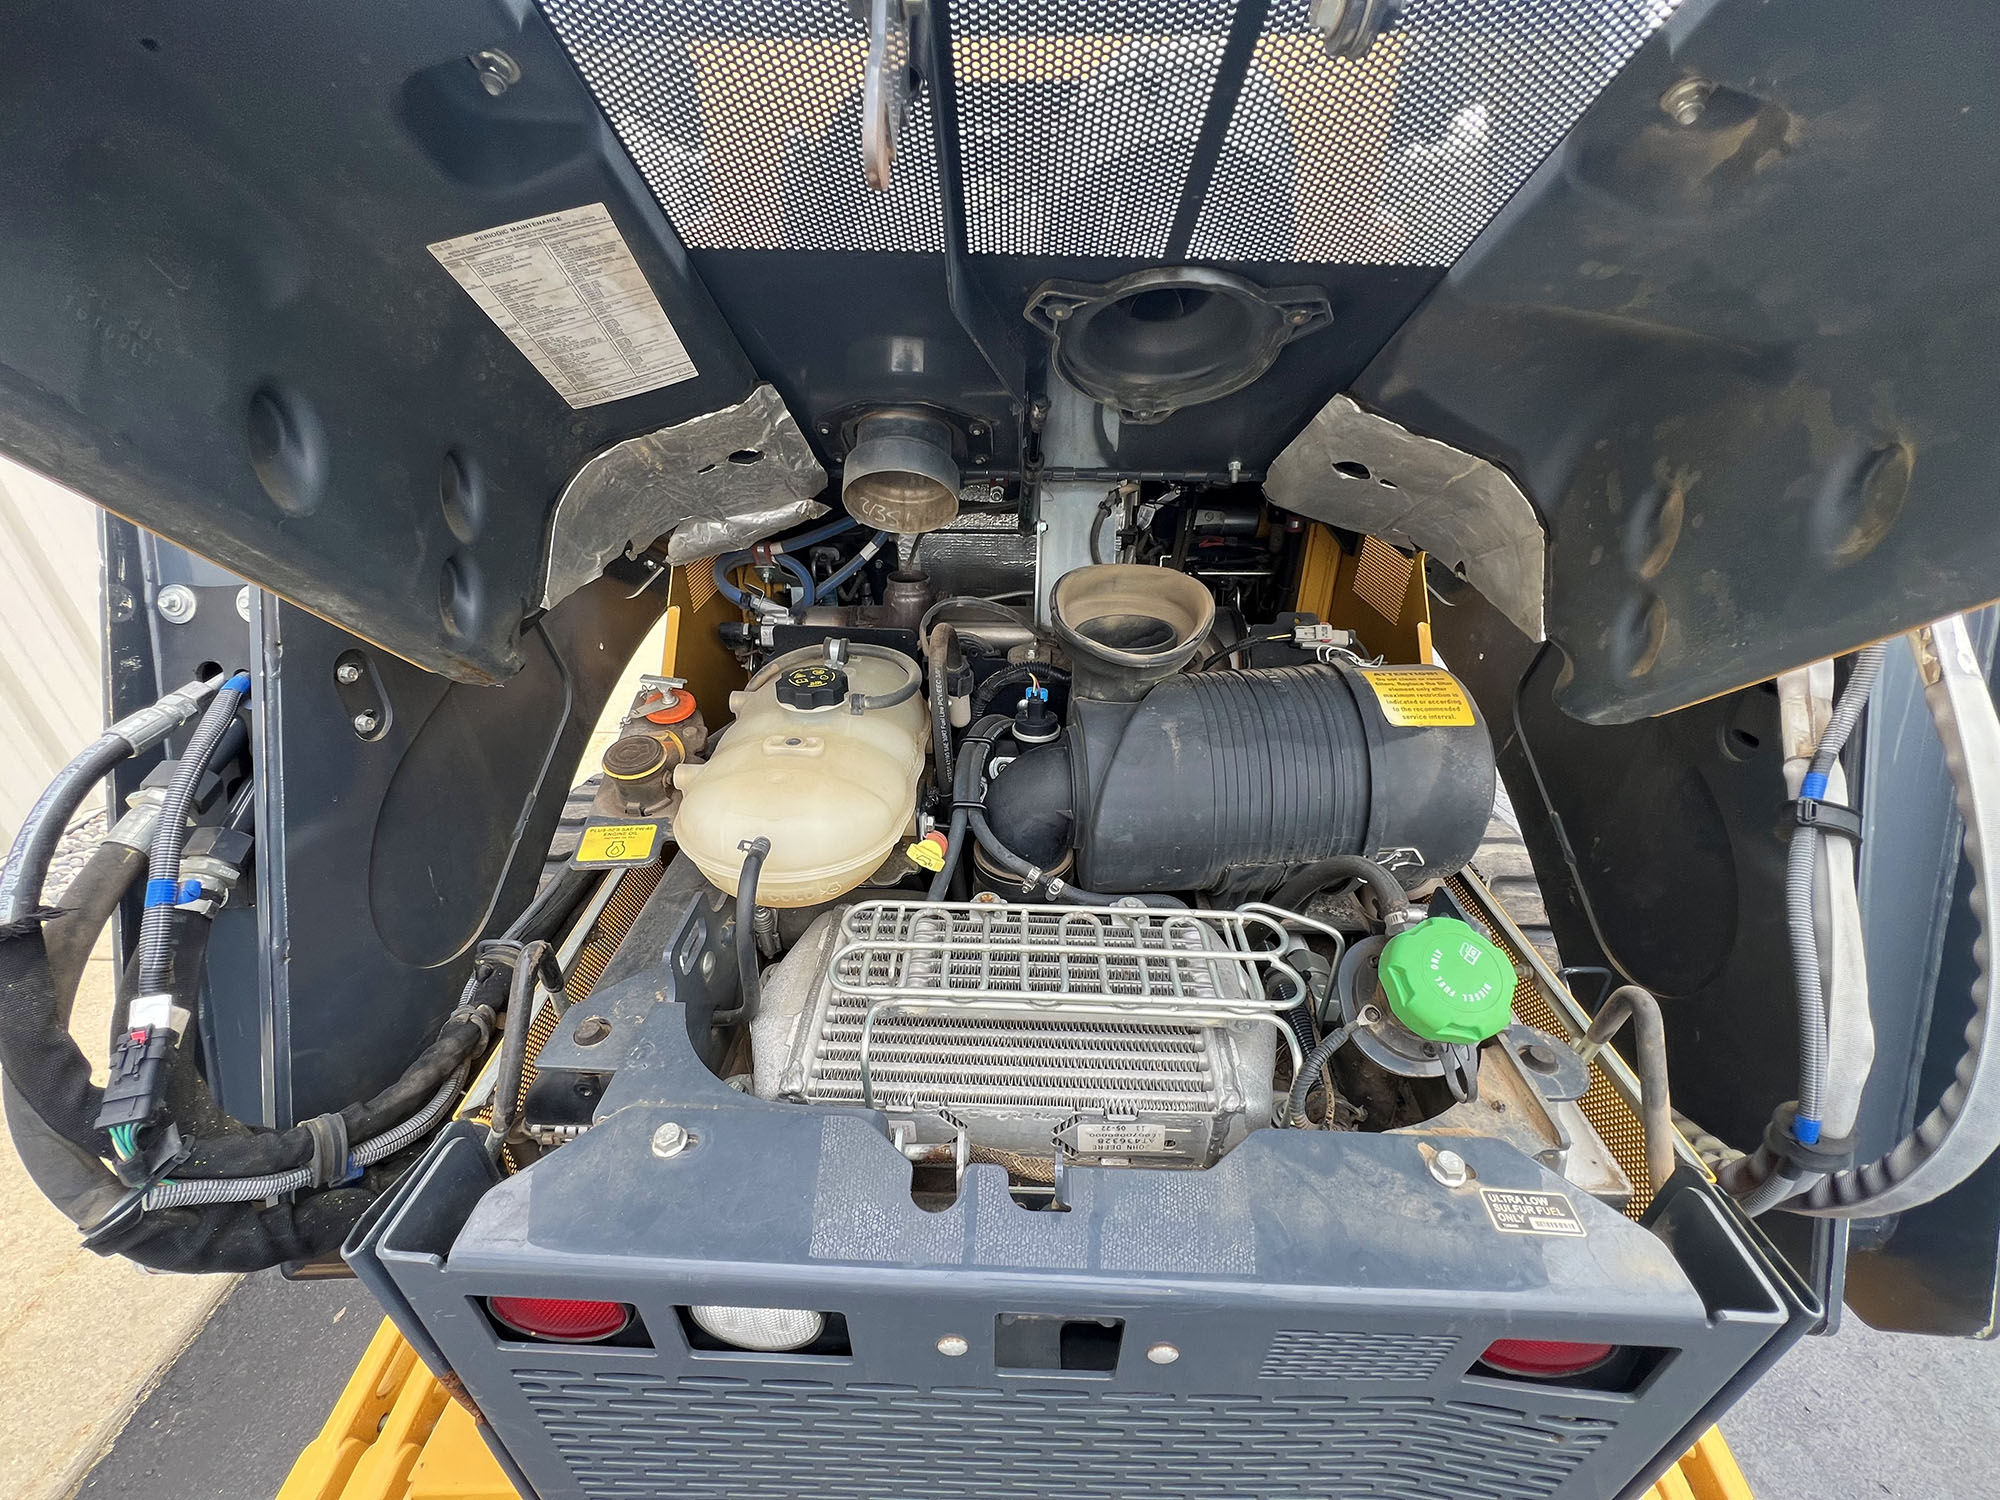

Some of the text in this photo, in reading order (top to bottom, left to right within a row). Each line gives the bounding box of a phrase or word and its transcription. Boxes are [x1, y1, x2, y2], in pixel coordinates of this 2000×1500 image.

[474, 216, 562, 242] PERIODIC MAINTENANCE
[1430, 948, 1492, 1002] DIESEL FUEL ONLY
[1488, 1194, 1548, 1206] ULTRA LOW
[1493, 1204, 1565, 1216] SULFUR FUEL
[1497, 1213, 1525, 1223] ONLY
